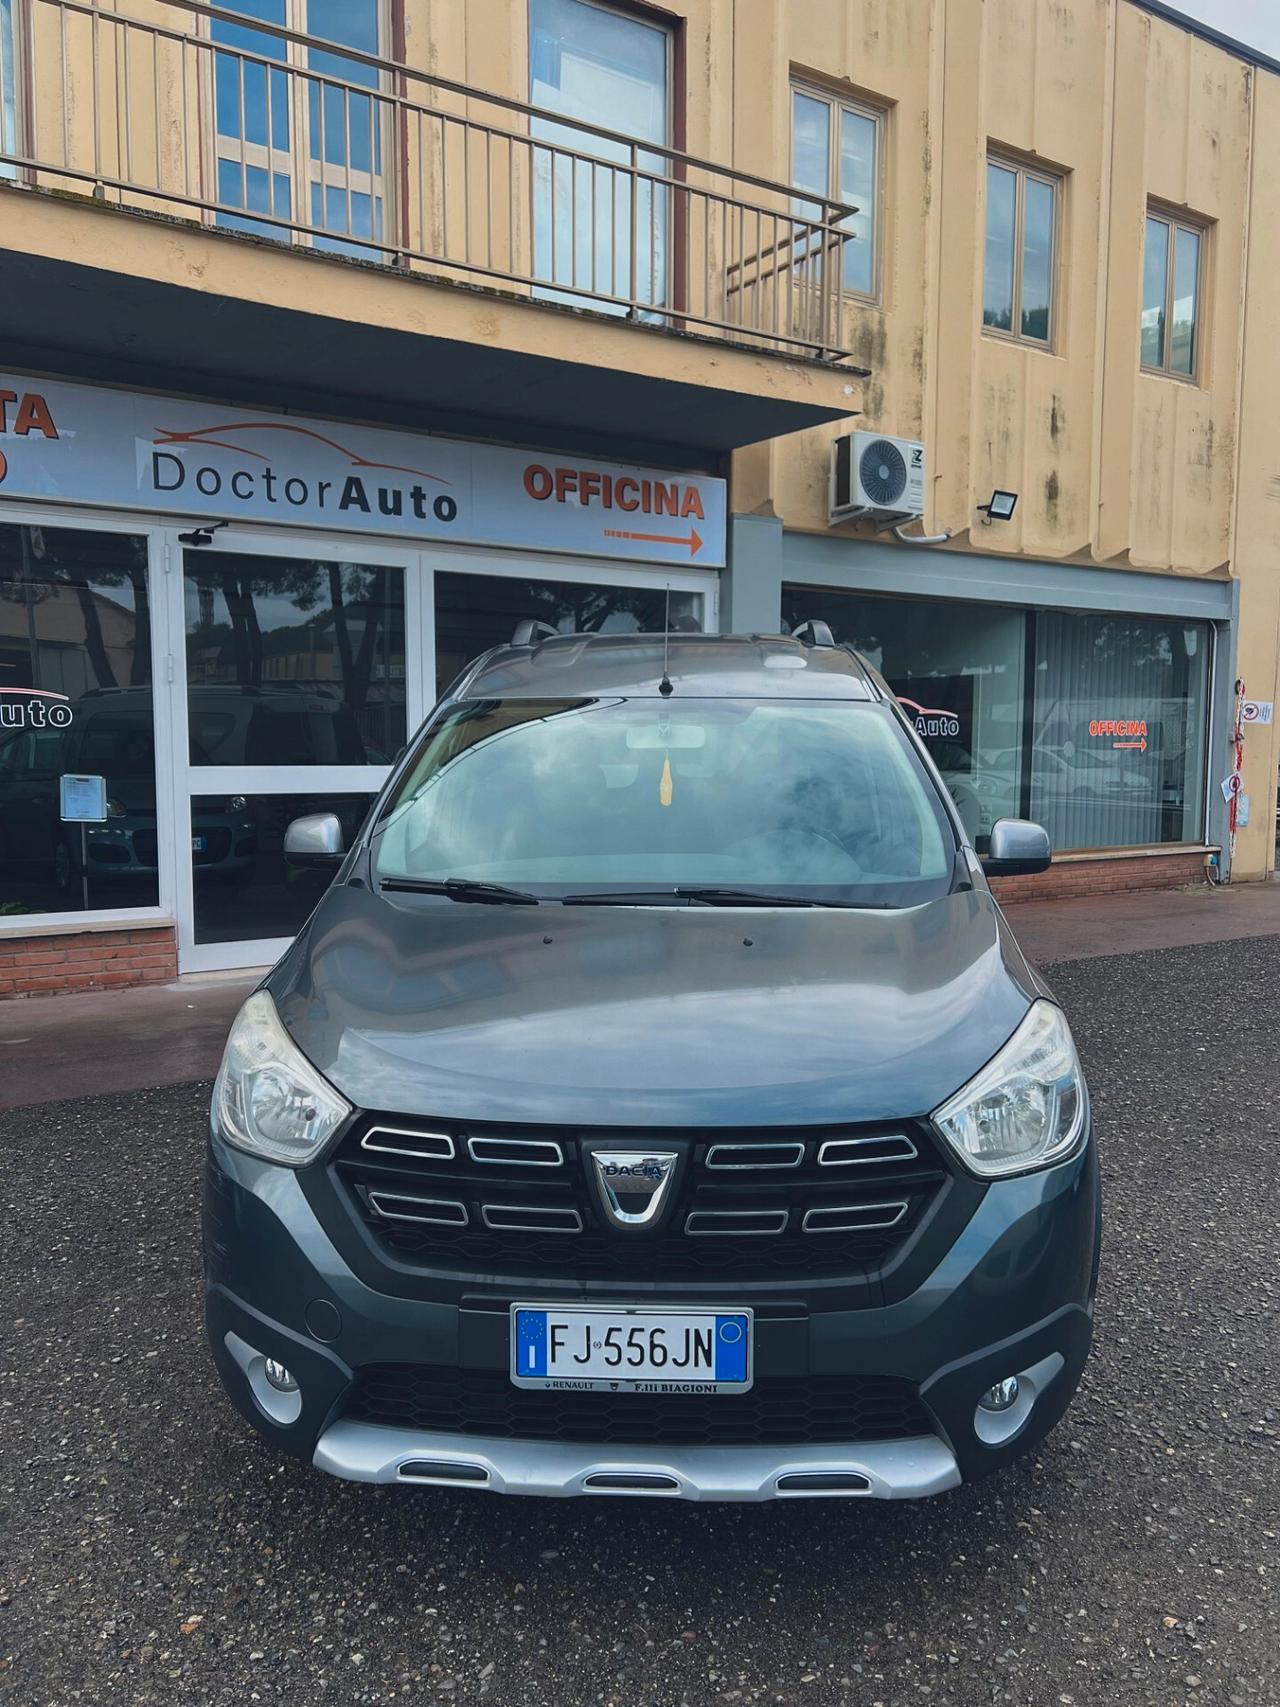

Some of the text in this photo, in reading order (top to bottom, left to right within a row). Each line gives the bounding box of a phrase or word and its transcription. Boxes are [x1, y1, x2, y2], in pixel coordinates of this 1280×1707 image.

[523, 464, 705, 520] OFFICINA
[1088, 720, 1147, 736] OFFICINA
[605, 1165, 661, 1177] DACIA
[552, 1381, 593, 1390] RENAULT
[661, 1384, 717, 1393] BIAGIONI
